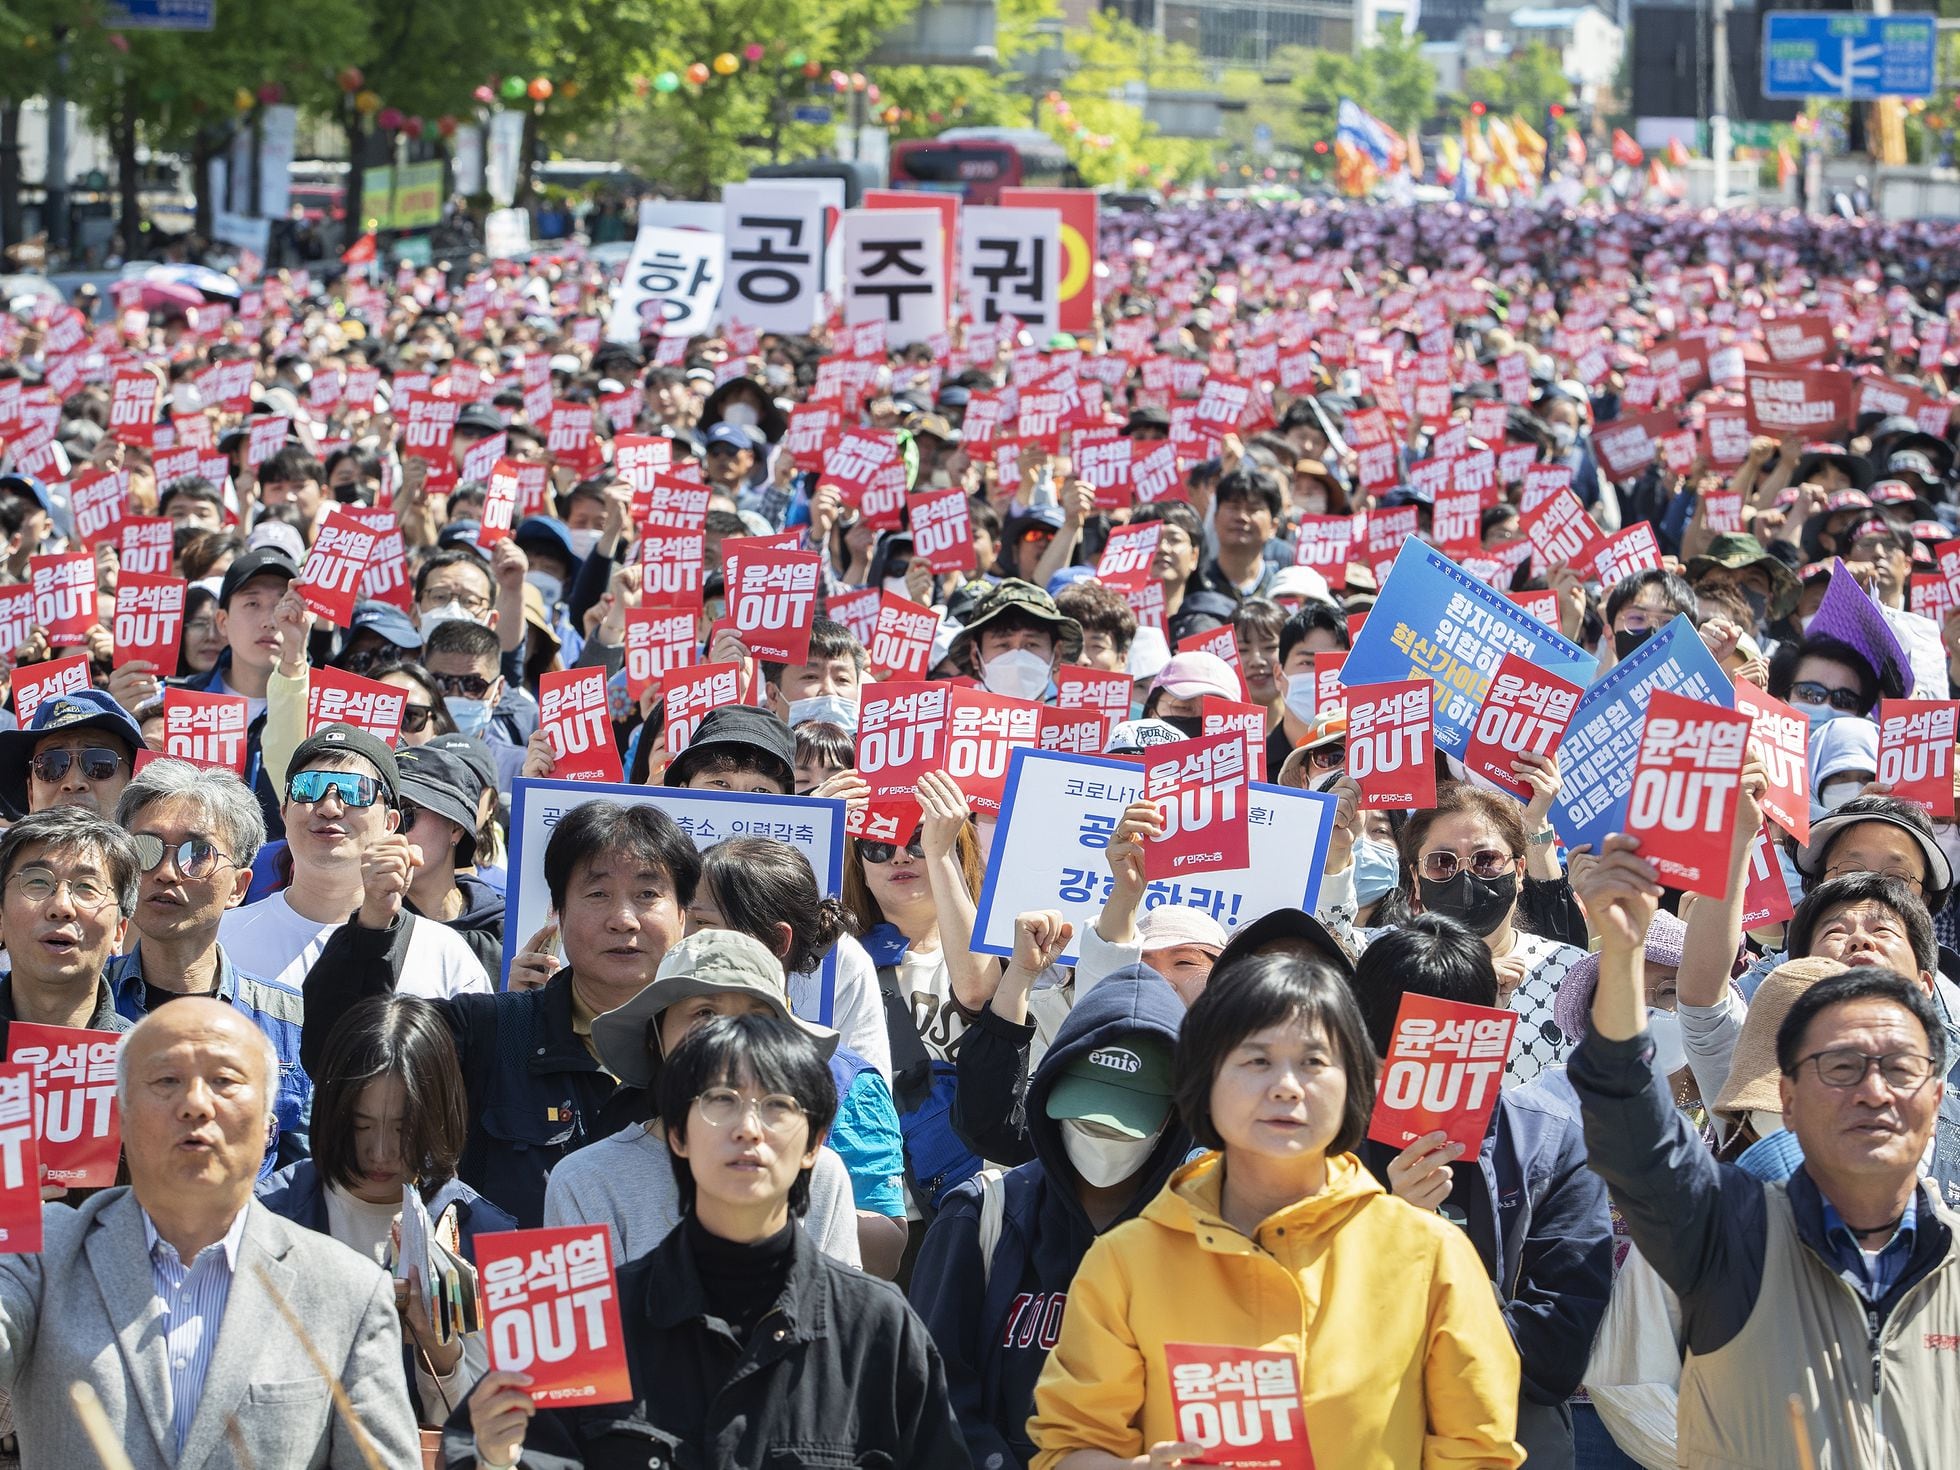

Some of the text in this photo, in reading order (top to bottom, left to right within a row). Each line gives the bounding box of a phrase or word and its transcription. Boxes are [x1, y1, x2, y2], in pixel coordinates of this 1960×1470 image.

[731, 217, 810, 303] 공
[637, 253, 712, 322] 항
[855, 241, 932, 321] 주
[973, 238, 1044, 325] 권
[110, 399, 153, 425] OUT
[1019, 413, 1061, 438] OUT
[1197, 399, 1245, 425] OUT
[406, 422, 454, 447] OUT
[551, 428, 590, 451] OUT
[617, 441, 671, 467] 윤석열
[826, 454, 880, 484] OUT
[1080, 461, 1132, 488] OUT
[1135, 465, 1178, 502] OUT
[72, 475, 120, 513] 윤석열
[651, 486, 708, 513] 윤석열
[861, 485, 907, 517] OUT
[911, 491, 968, 528] 윤석열
[75, 497, 122, 538] OUT
[122, 521, 173, 545] 윤석열
[649, 510, 705, 530] OUT
[914, 514, 969, 557] OUT
[1300, 518, 1351, 541] 윤석열
[1433, 514, 1481, 544] OUT
[1529, 490, 1580, 550] 윤석열
[317, 527, 376, 561] 윤석열
[643, 534, 702, 562] 윤석열
[1106, 524, 1161, 555] 윤석열
[1297, 541, 1348, 566] OUT
[1545, 510, 1595, 567] OUT
[1594, 526, 1654, 571] 윤석열
[33, 557, 95, 595] 윤석열
[120, 550, 170, 574] OUT
[303, 554, 364, 593] OUT
[643, 561, 702, 594] OUT
[742, 562, 818, 593] 윤석열
[1098, 550, 1153, 577] OUT
[1600, 548, 1659, 591] OUT
[36, 584, 97, 626] OUT
[117, 584, 184, 613] 윤석열
[737, 592, 814, 631] OUT
[115, 612, 181, 648] OUT
[628, 614, 696, 648] 윤석열
[877, 606, 938, 642] 윤석열
[1445, 592, 1537, 660] 환자안전
[628, 641, 696, 681] OUT
[872, 633, 933, 674] OUT
[1433, 621, 1502, 678] 위협하
[17, 661, 90, 720] 윤석열
[318, 687, 403, 726] 윤석열
[541, 674, 606, 724] 윤석열
[667, 669, 737, 720] 윤석열
[1060, 680, 1130, 709] 윤석열
[1407, 666, 1479, 731] 기하
[1493, 674, 1578, 721] 윤석열
[1676, 672, 1710, 704] 대!
[167, 703, 245, 733] 윤석열
[862, 688, 946, 733] 윤석열
[952, 707, 1038, 738] 윤석열
[1205, 714, 1264, 742] 윤석열
[1350, 687, 1430, 739] 윤석열
[1556, 657, 1685, 773] 영리병원 반대!
[1737, 700, 1806, 755] 윤석열
[1883, 707, 1955, 748] 윤석열
[167, 732, 245, 765] OUT
[543, 706, 607, 761] OUT
[859, 721, 944, 774] OUT
[1041, 720, 1101, 752] 윤석열
[1477, 705, 1562, 757] OUT
[1640, 718, 1748, 769] 윤석열
[1149, 737, 1245, 796] 윤석열
[1349, 722, 1430, 780] OUT
[1879, 739, 1953, 785] OUT
[1149, 775, 1246, 842] OUT
[1381, 792, 1413, 803] 민주노총
[1628, 768, 1738, 833] OUT
[1187, 851, 1223, 865] 민주노총
[1394, 1019, 1512, 1059] 윤석열
[12, 1041, 120, 1087] 윤석열
[1088, 1050, 1140, 1073] emis
[1383, 1061, 1501, 1113] OUT
[484, 1233, 610, 1310] 윤석열
[491, 1285, 612, 1372] OUT
[1173, 1358, 1298, 1401] 윤석열
[1178, 1397, 1299, 1449] OUT
